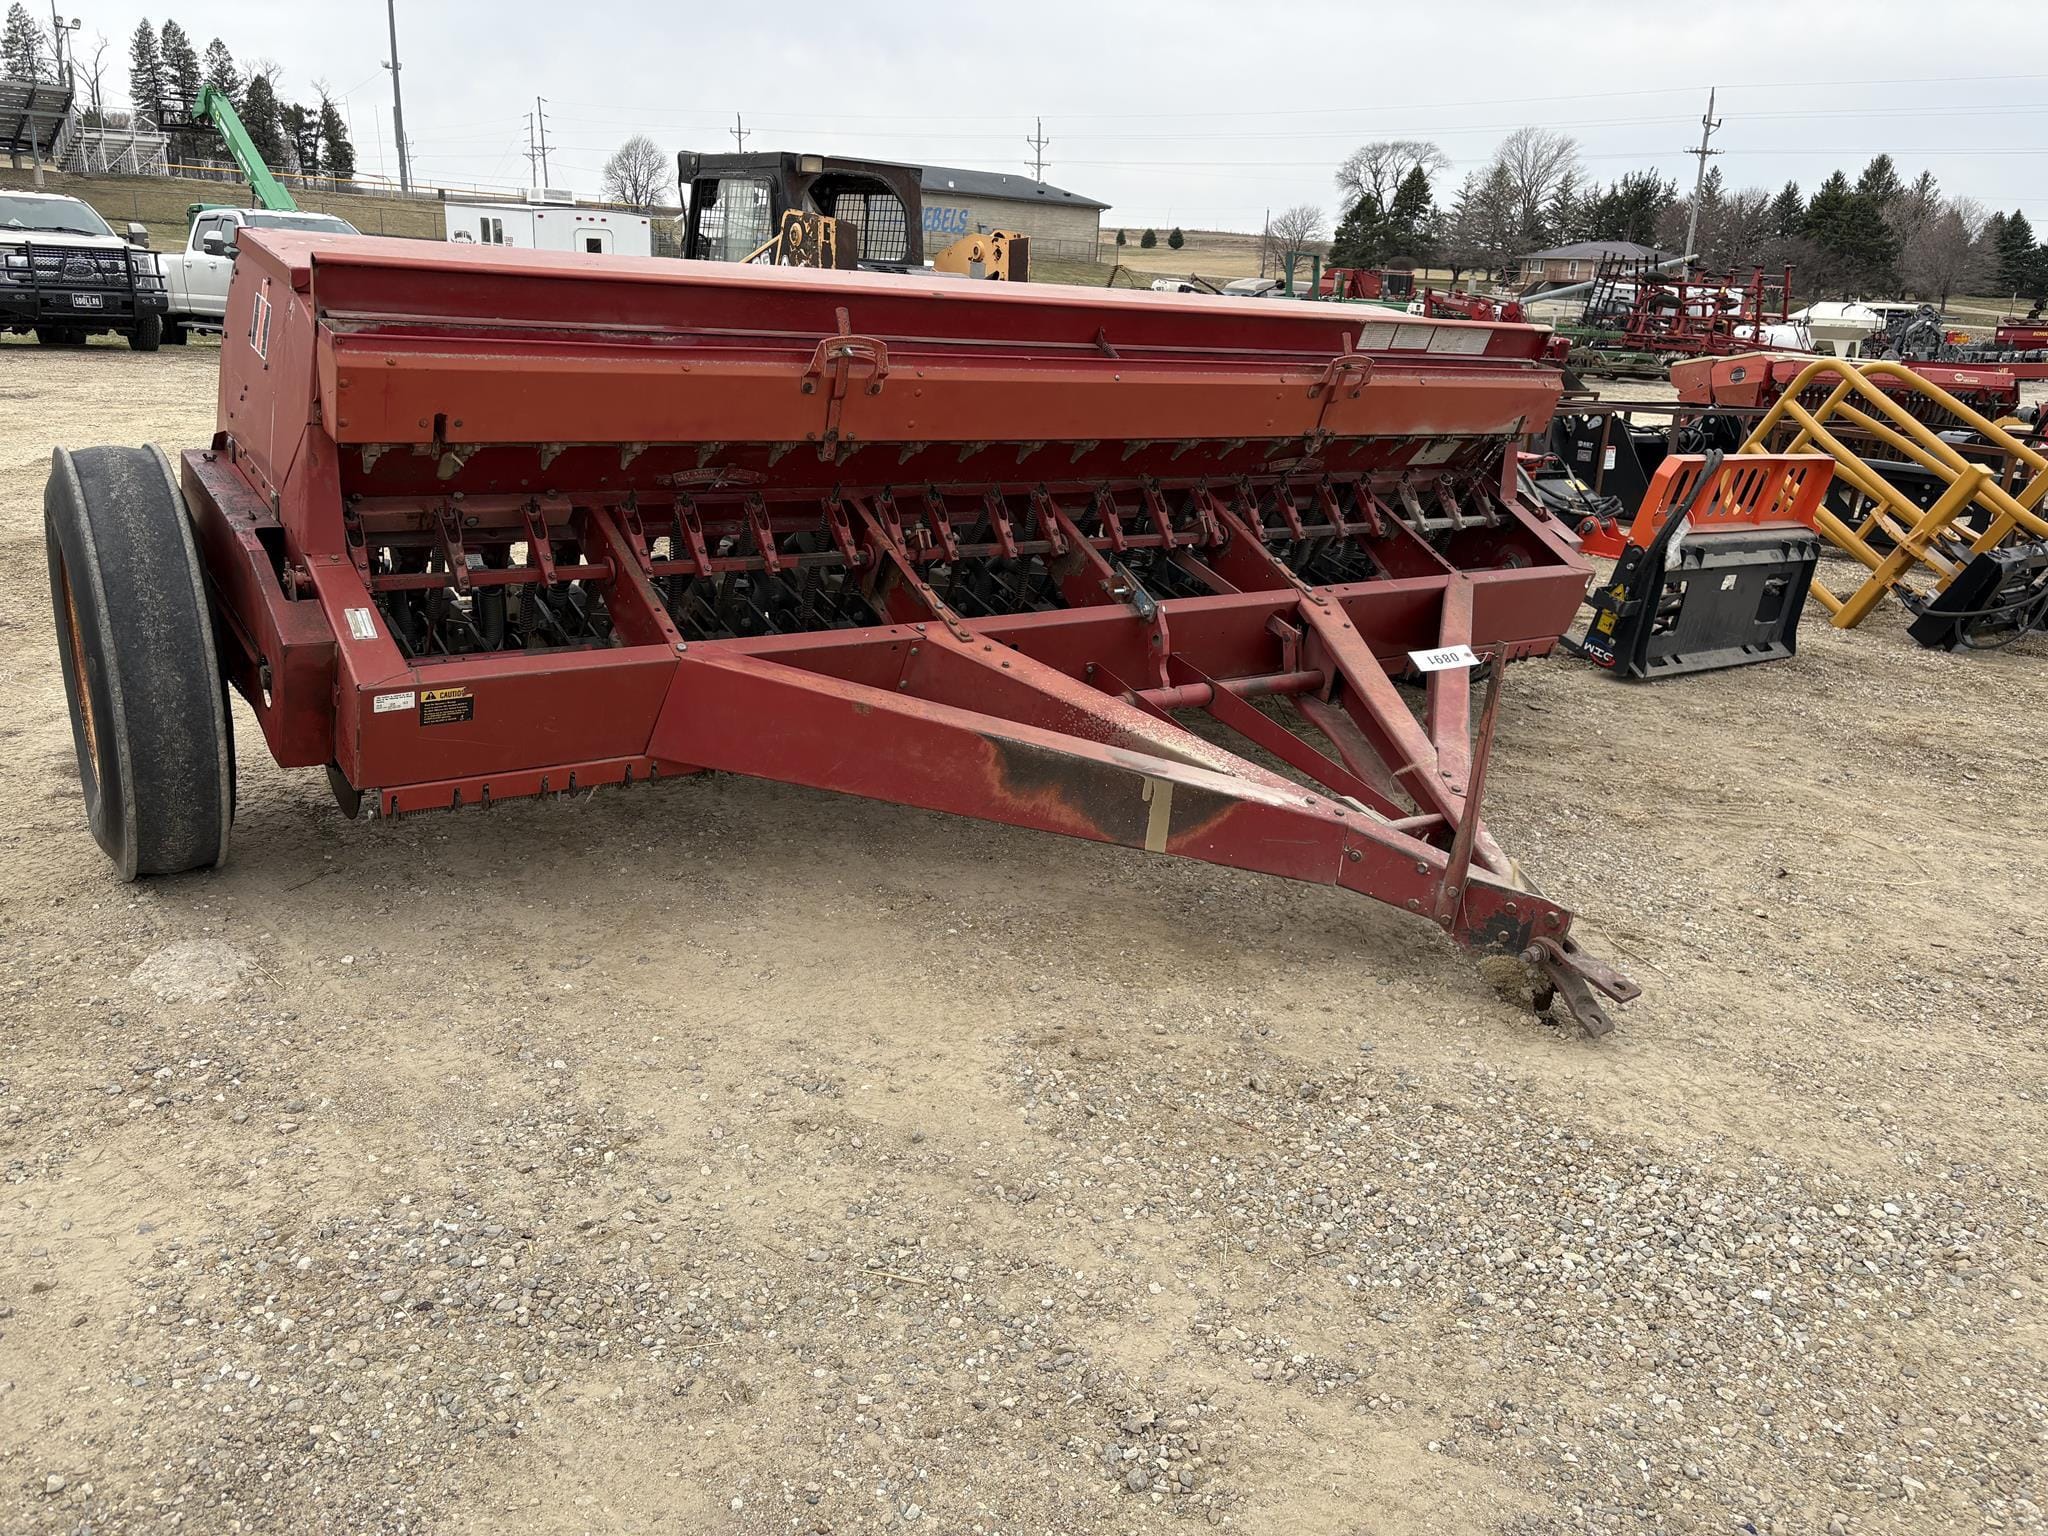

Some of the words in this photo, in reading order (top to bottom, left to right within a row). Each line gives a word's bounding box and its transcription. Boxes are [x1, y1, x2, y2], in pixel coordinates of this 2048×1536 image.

[922, 207, 969, 233] EBELS
[1427, 651, 1460, 665] 0891
[439, 690, 466, 699] CAUTIO
